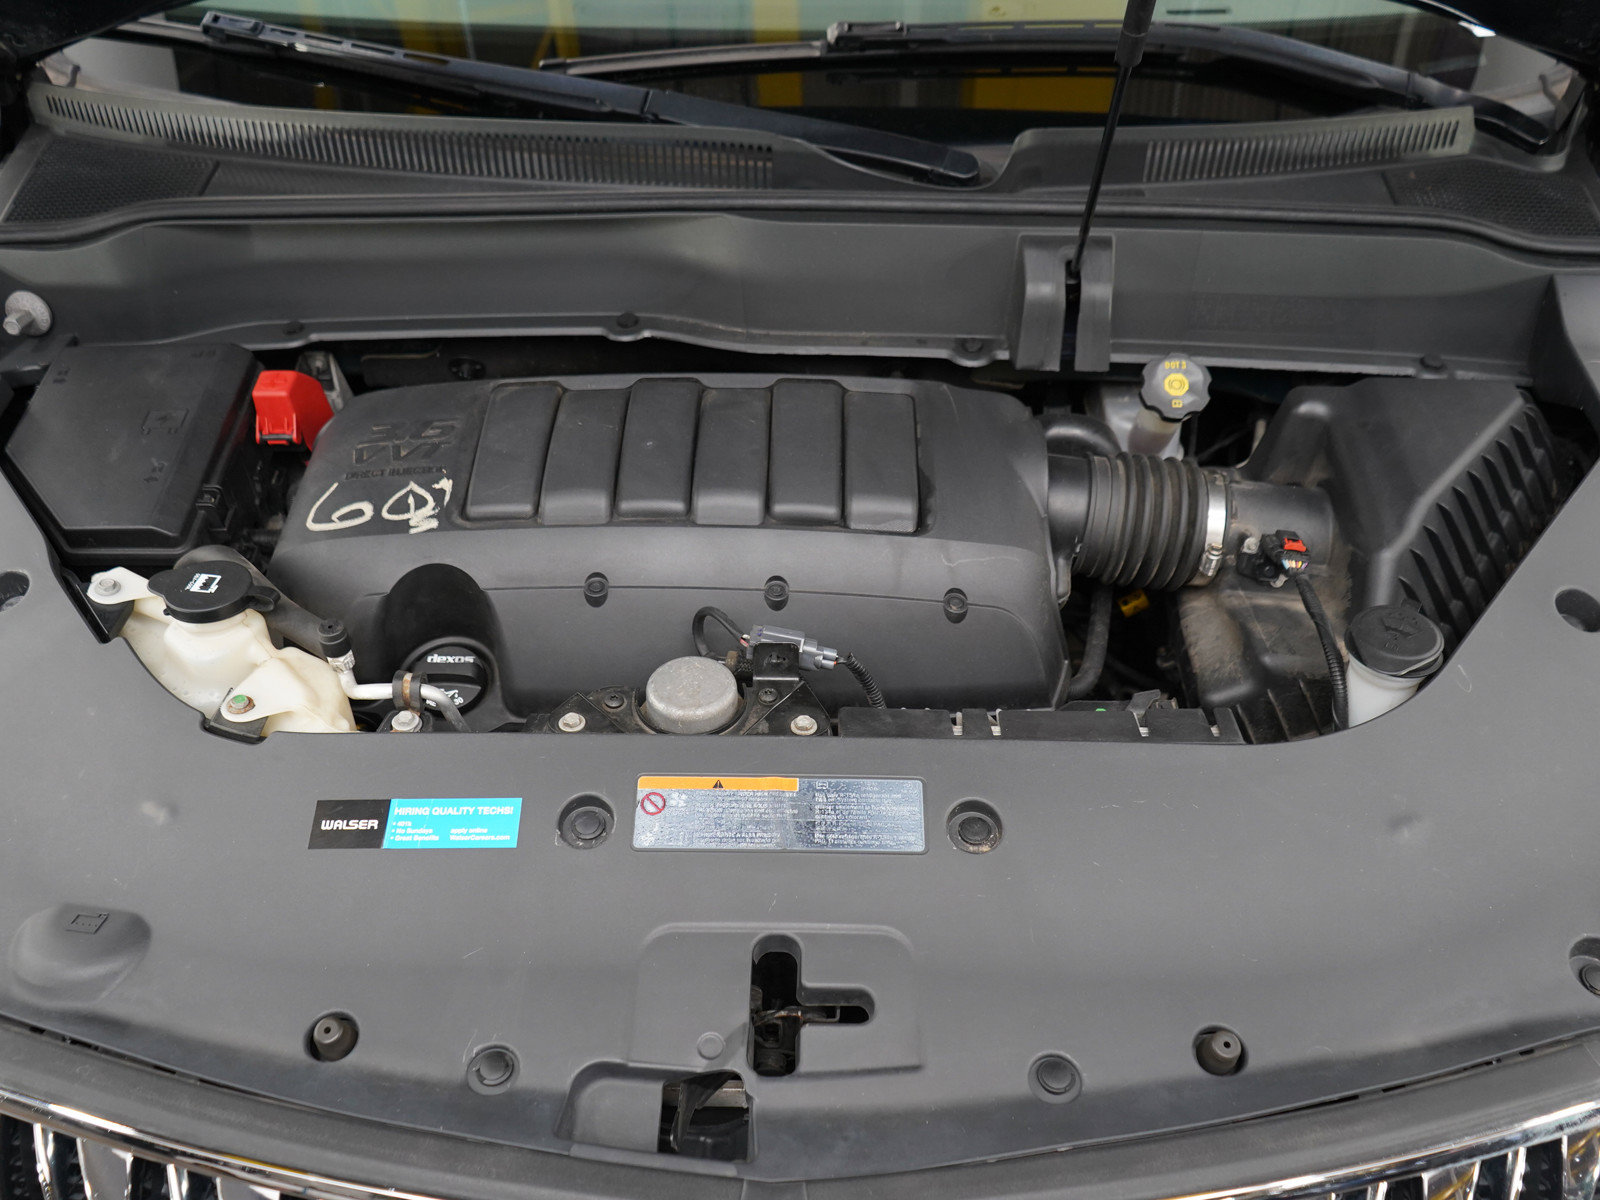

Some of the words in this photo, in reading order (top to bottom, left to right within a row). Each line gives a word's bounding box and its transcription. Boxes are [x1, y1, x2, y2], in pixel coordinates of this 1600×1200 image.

[1165, 361, 1179, 369] DOT
[427, 653, 476, 663] dexos
[394, 806, 430, 815] HIRING
[432, 806, 475, 815] QUALITY
[477, 806, 514, 815] TECHS!
[320, 819, 379, 831] WALSER
[407, 827, 433, 835] Sundays
